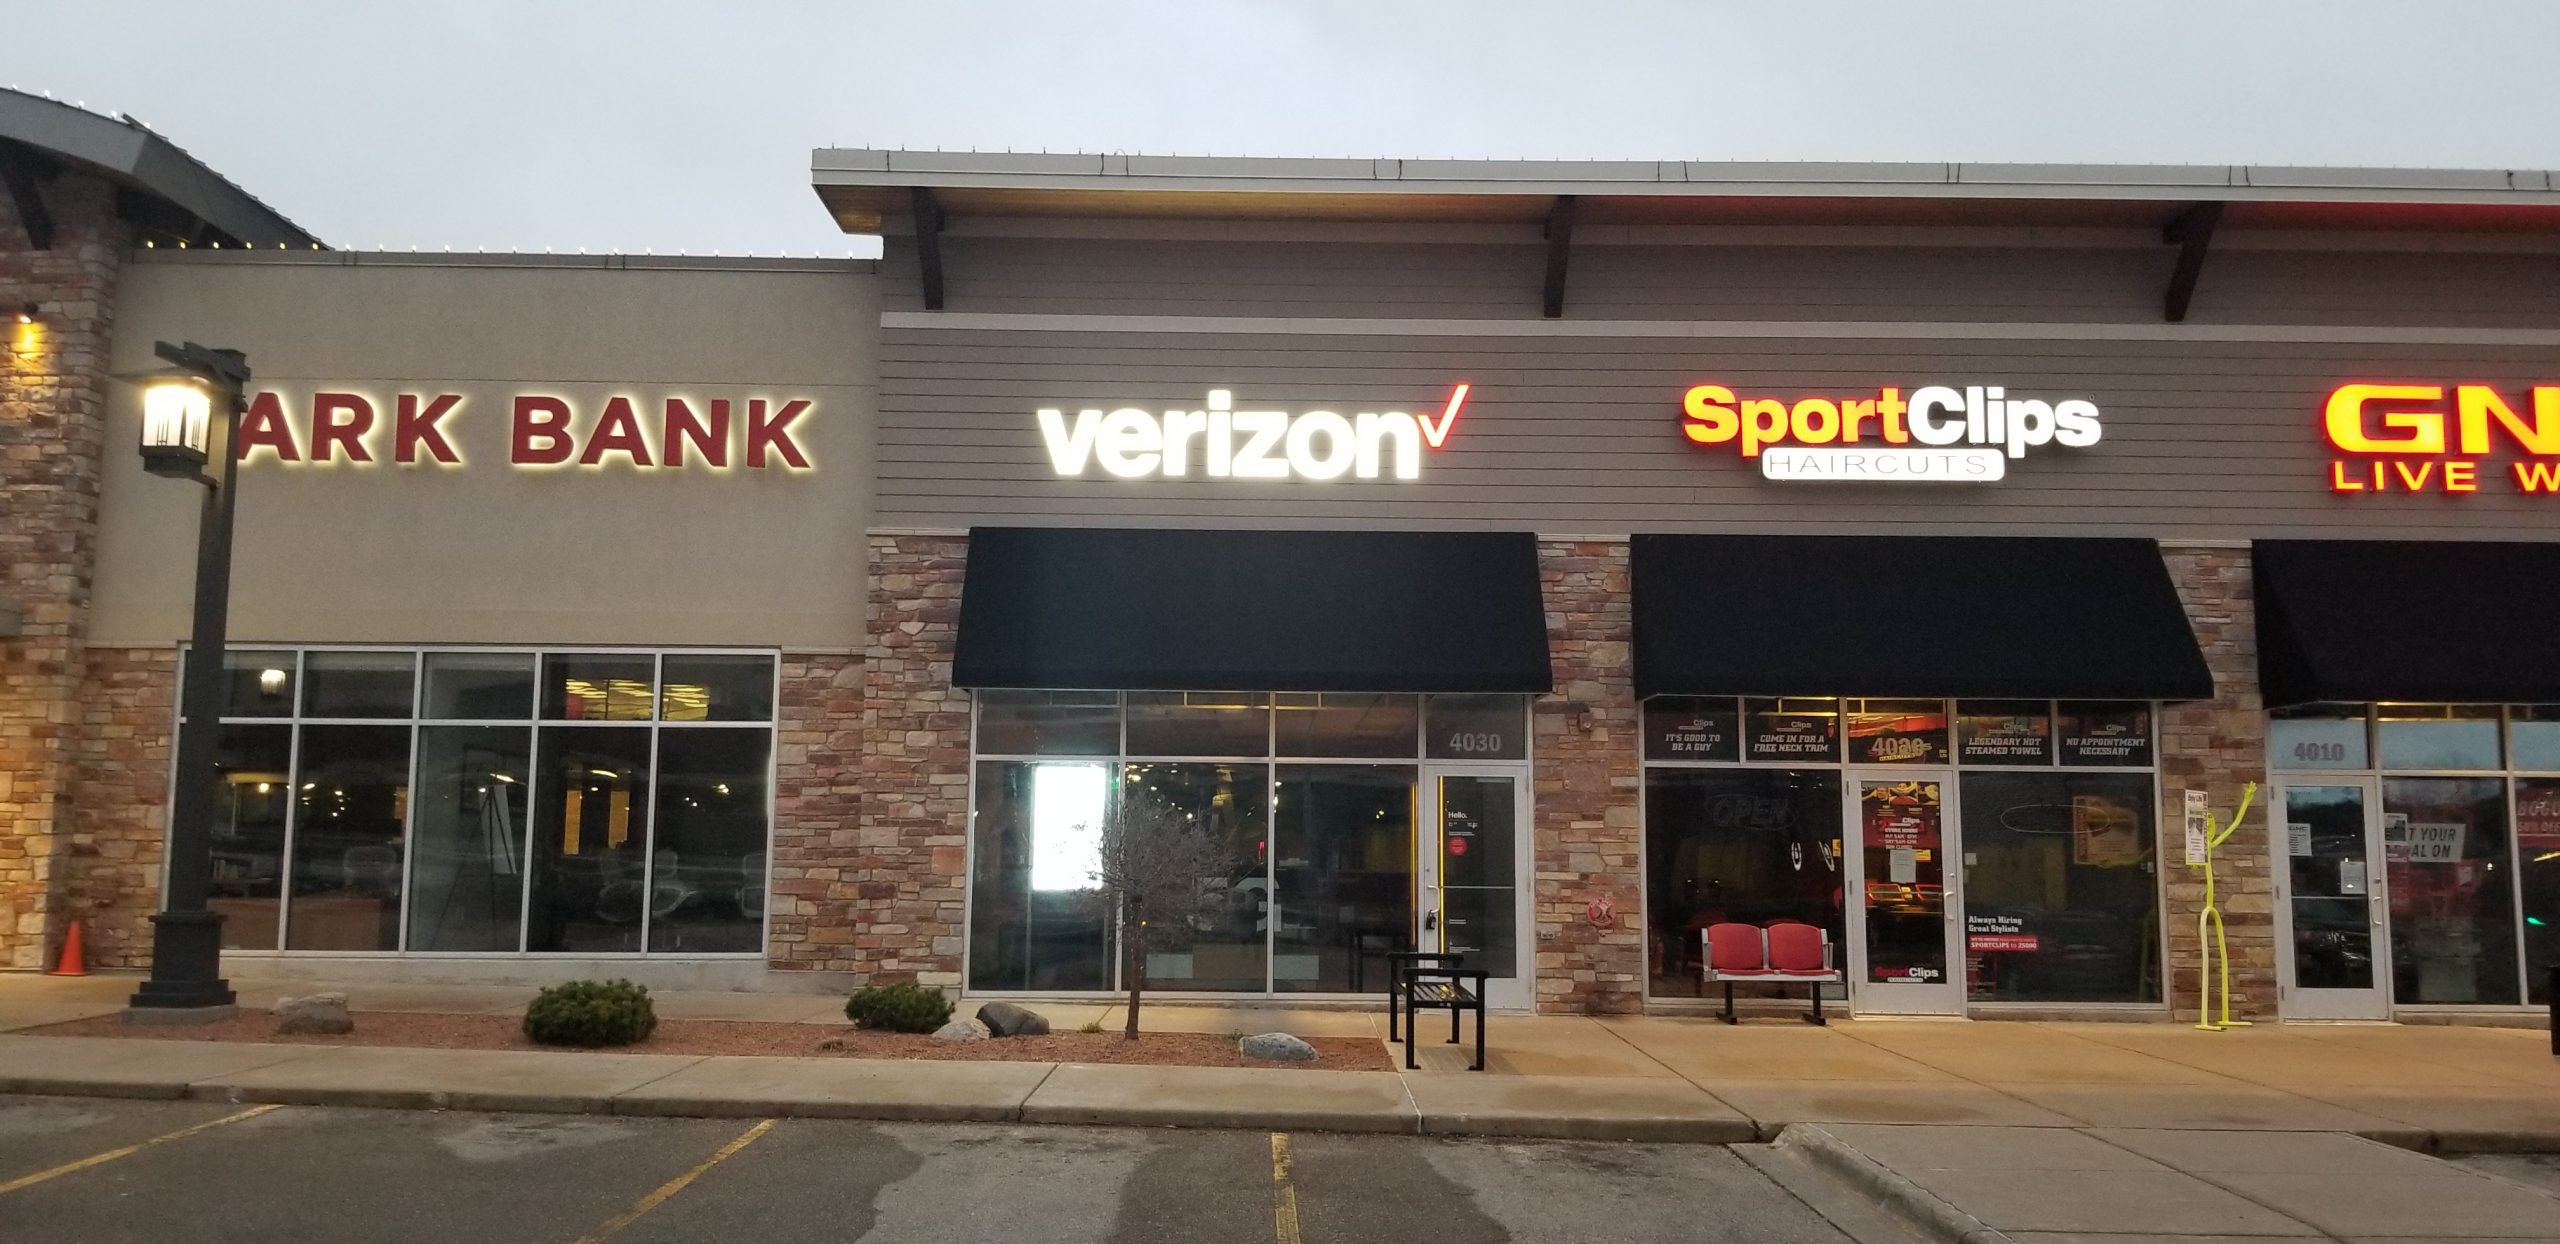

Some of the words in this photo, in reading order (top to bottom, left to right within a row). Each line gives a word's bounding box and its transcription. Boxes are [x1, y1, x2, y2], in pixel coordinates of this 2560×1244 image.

[2325, 383, 2560, 454] GN
[236, 391, 463, 463] ARK
[511, 396, 812, 468] BANK
[1036, 389, 1420, 480] verizon
[1768, 454, 1987, 475] HAIRCUTS
[2334, 461, 2476, 491] LIVE
[1449, 732, 1502, 752] 4030
[1665, 733, 1682, 742] IT'S
[1684, 733, 1707, 742] GOOD
[1708, 733, 1721, 742] TO
[1760, 734, 1785, 743] COME
[1786, 734, 1799, 743] IN
[1800, 734, 1817, 743] FOR
[1817, 734, 1825, 743] A
[1968, 737, 2021, 746] LEGENDARY
[2023, 737, 2042, 746] HOT
[2066, 737, 2080, 746] NO
[2081, 738, 2145, 747] APPOINTMENT
[1672, 742, 1685, 751] BE
[1685, 742, 1693, 751] A
[1694, 742, 1712, 751] GUY
[1754, 743, 1777, 752] FREE
[1778, 743, 1802, 752] NECK
[1803, 743, 1829, 753] TRIM
[1965, 747, 2009, 755] STEAMED
[2010, 747, 2042, 755] TOWEL
[2079, 747, 2130, 756] NECESSARY
[2294, 742, 2345, 761] 4010
[2420, 828, 2456, 841] YOUR
[2411, 844, 2427, 858] AL
[2432, 844, 2451, 858] ON
[1968, 916, 1997, 925] Always
[1998, 916, 2023, 926] Hiring
[1991, 925, 2019, 934] Stylists
